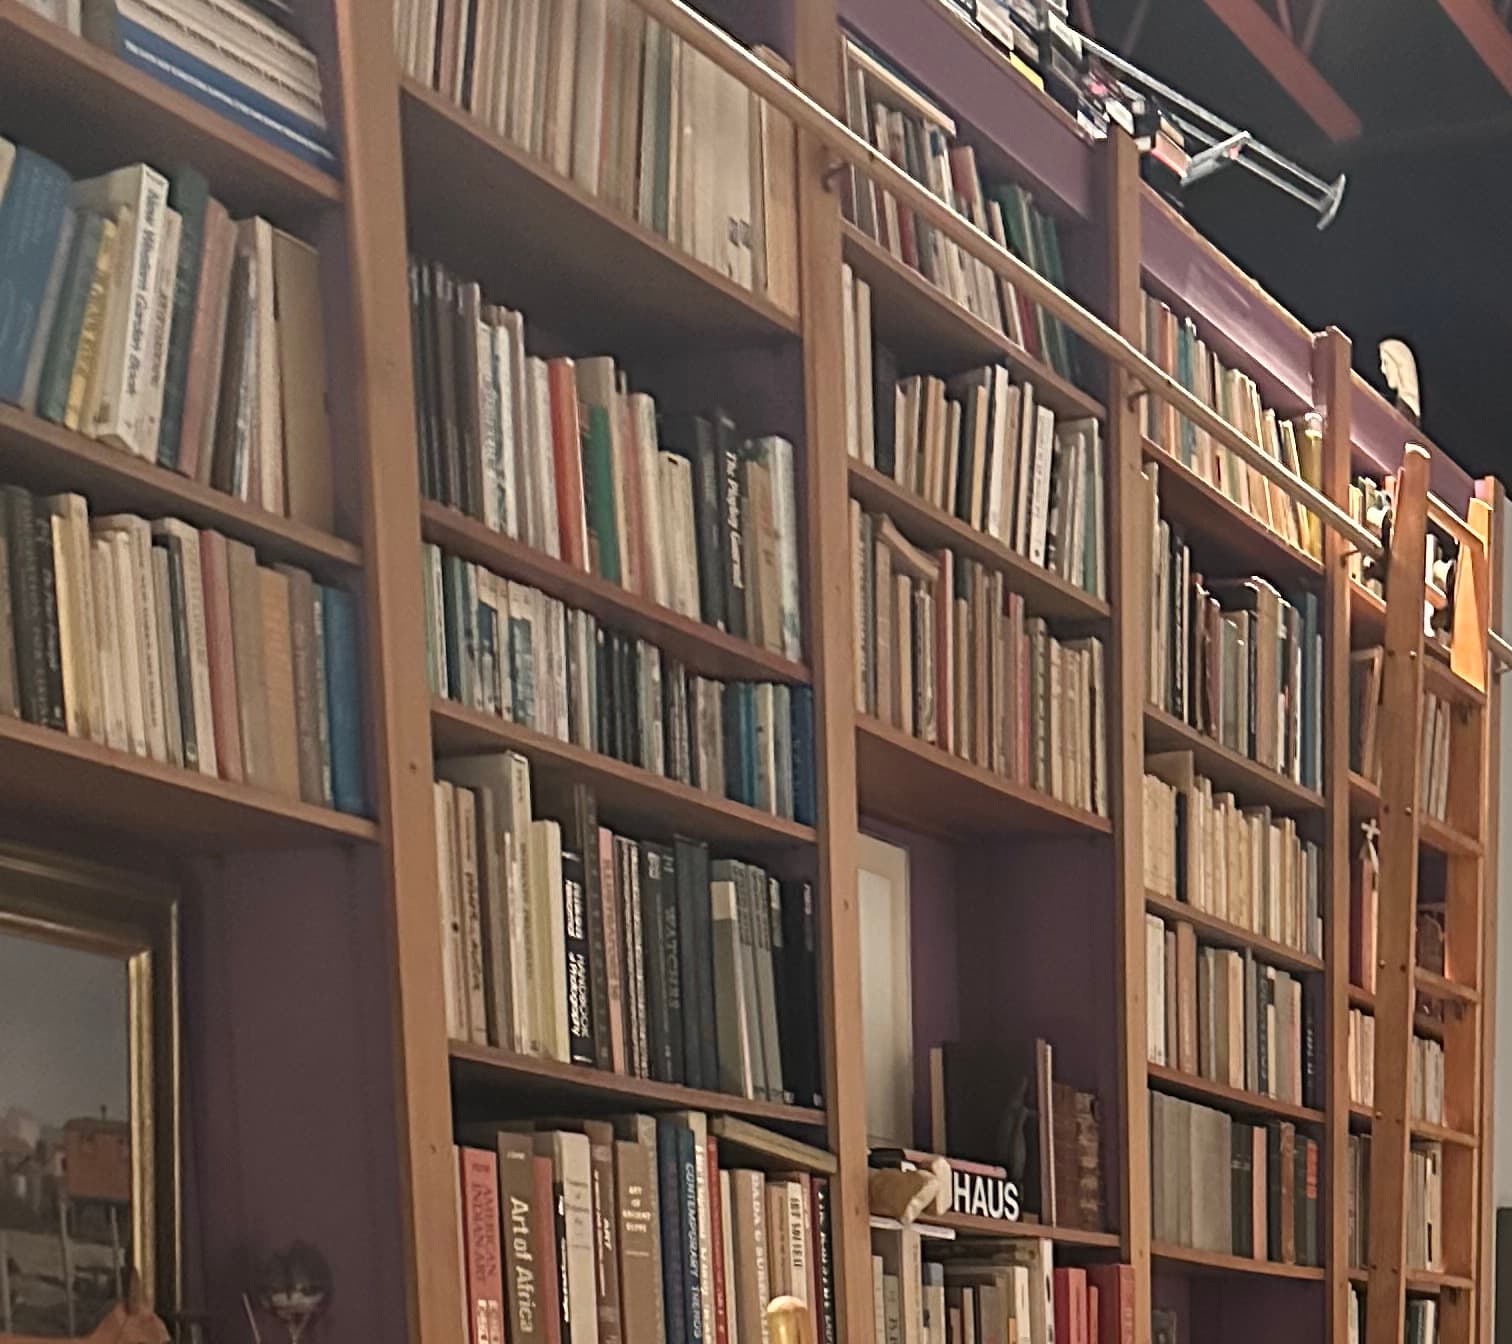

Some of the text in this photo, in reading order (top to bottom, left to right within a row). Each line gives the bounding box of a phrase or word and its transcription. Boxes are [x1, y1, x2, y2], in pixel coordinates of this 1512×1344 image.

[145, 189, 160, 223] New
[130, 293, 149, 352] Garden
[125, 354, 142, 396] Book
[725, 451, 739, 477] The
[472, 1184, 487, 1248] INDIAN
[482, 1182, 498, 1277] AMERICAN
[511, 1196, 537, 1333] Art of Africa
[684, 1164, 702, 1339] CONTEMPORARY TRENDS
